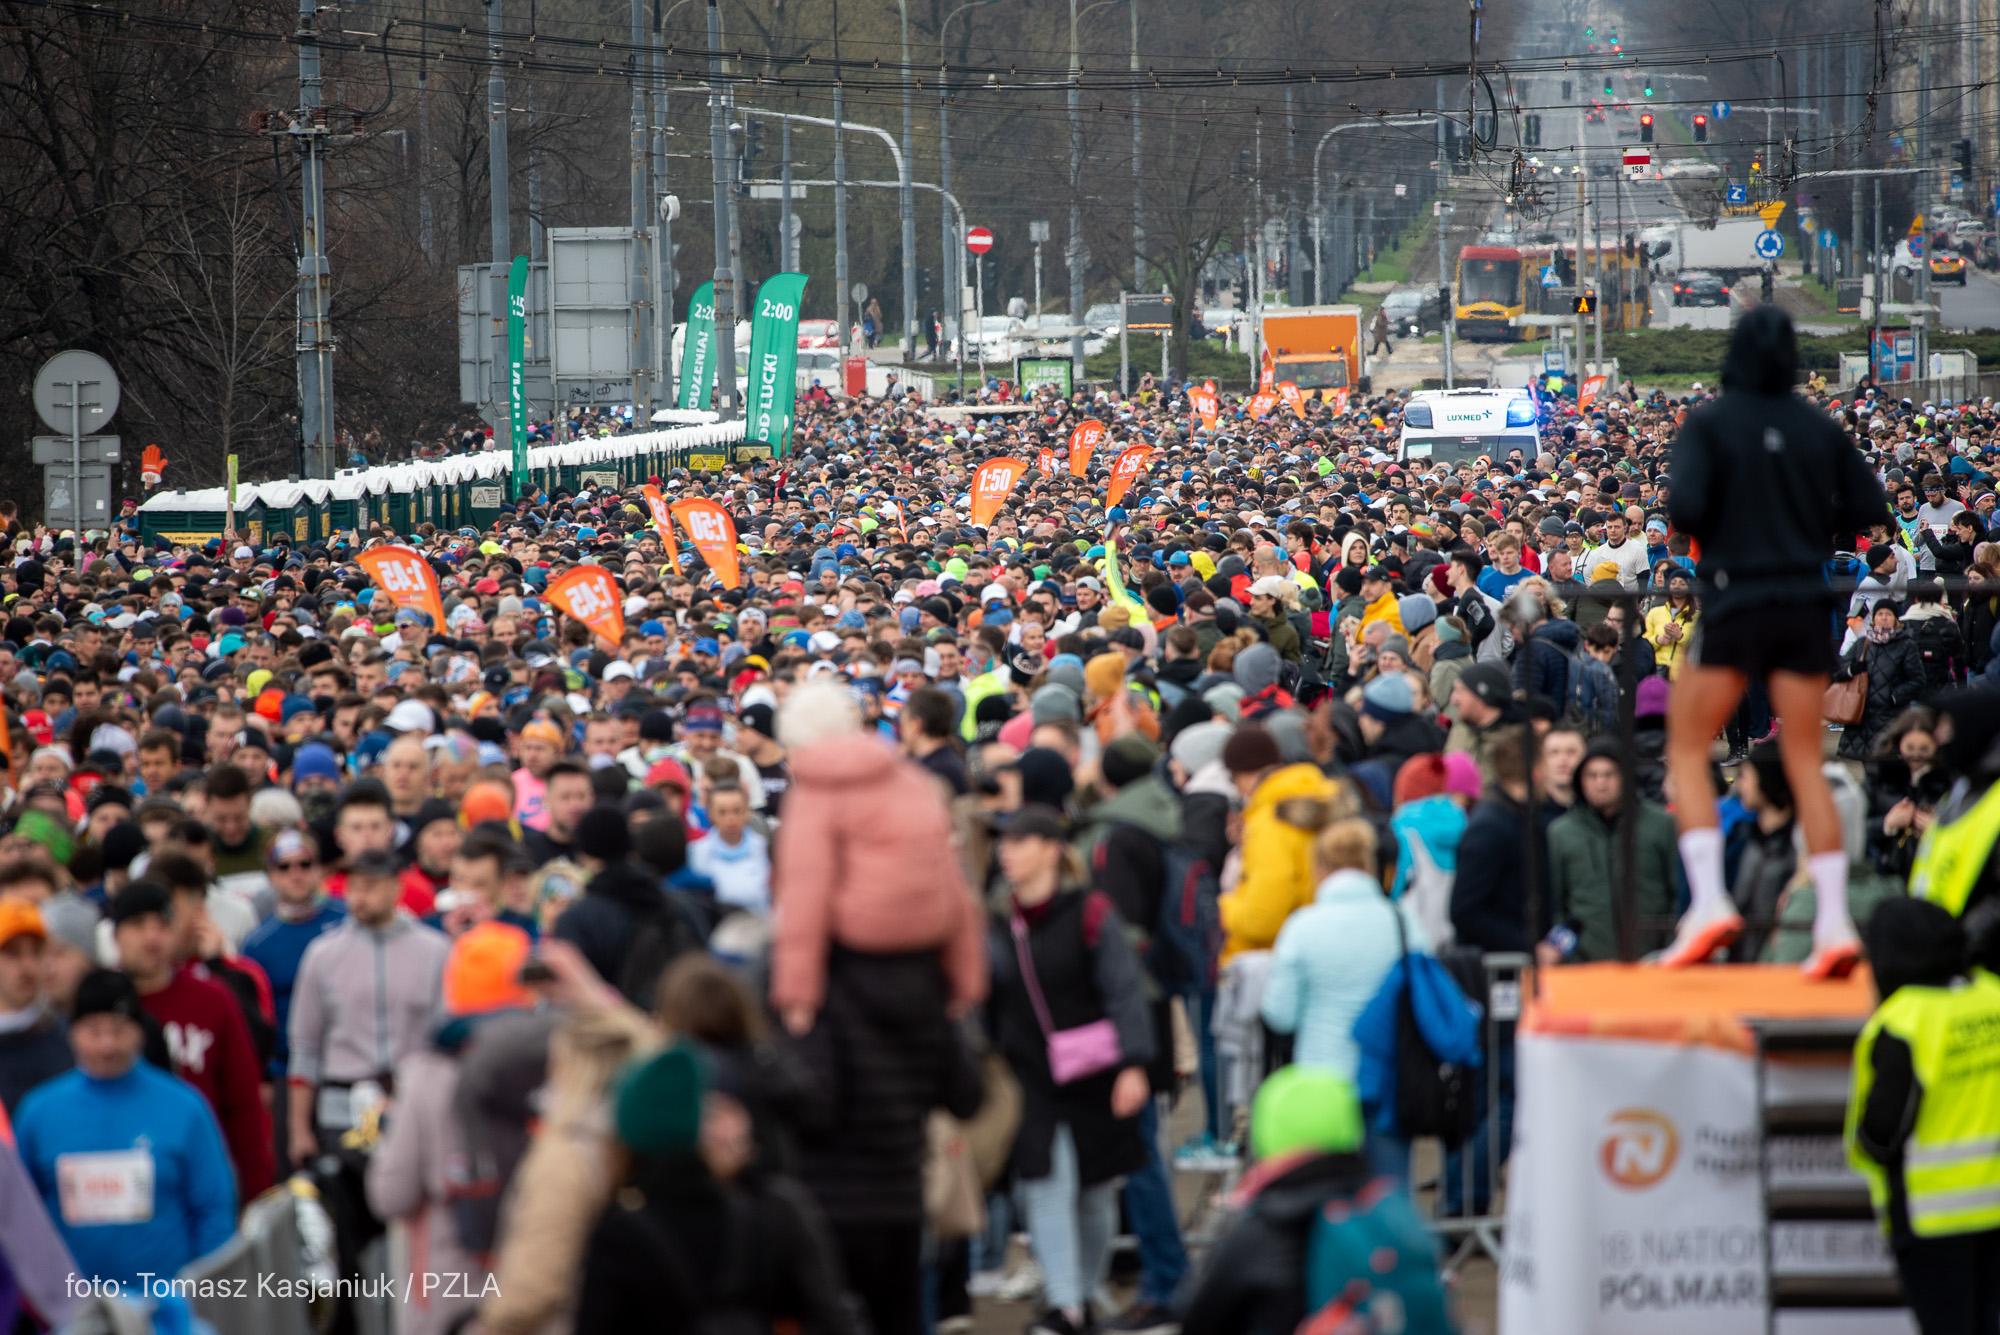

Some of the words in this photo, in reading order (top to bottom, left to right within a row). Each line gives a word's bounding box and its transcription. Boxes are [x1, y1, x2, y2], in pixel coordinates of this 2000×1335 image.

[1631, 166, 1644, 174] 158
[761, 299, 793, 321] 2:00
[1025, 366, 1066, 377] PIJESZ
[760, 353, 778, 409] LUCK!
[1446, 414, 1482, 422] LUXMED
[1083, 429, 1100, 445] 1:55
[979, 468, 1012, 492] 1:50
